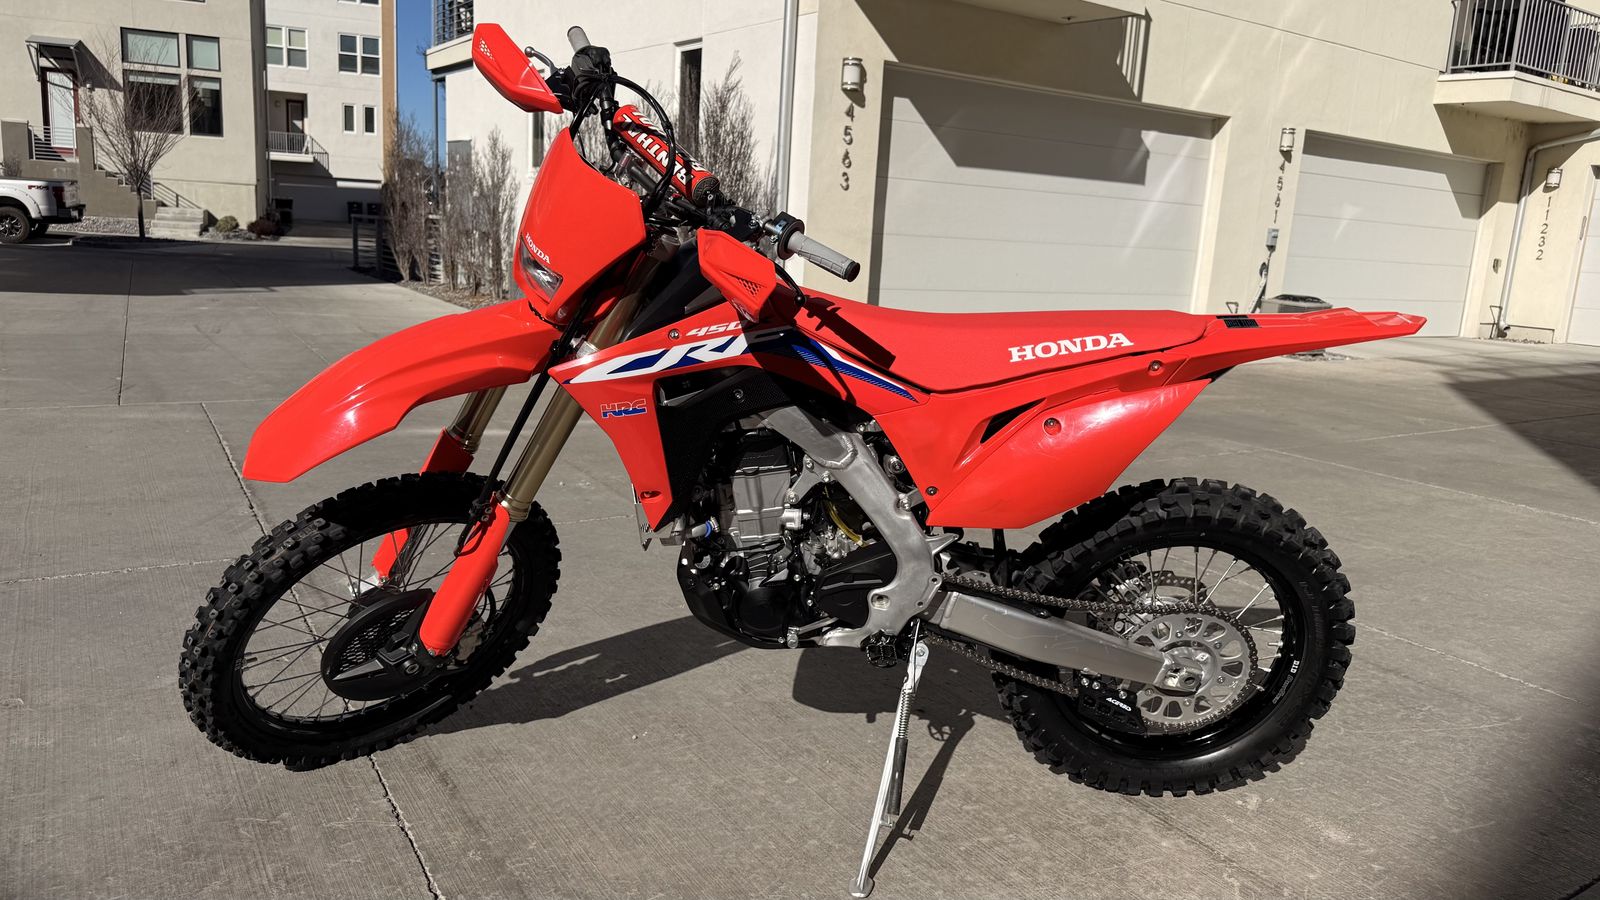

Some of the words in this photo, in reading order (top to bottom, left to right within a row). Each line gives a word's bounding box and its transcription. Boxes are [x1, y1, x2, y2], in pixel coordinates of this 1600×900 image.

[840, 102, 855, 191] 4563
[1273, 159, 1286, 224] 4561
[525, 232, 551, 265] HONDA
[1535, 196, 1552, 261] 11232
[1008, 332, 1134, 363] HONDA
[600, 398, 647, 418] HRC
